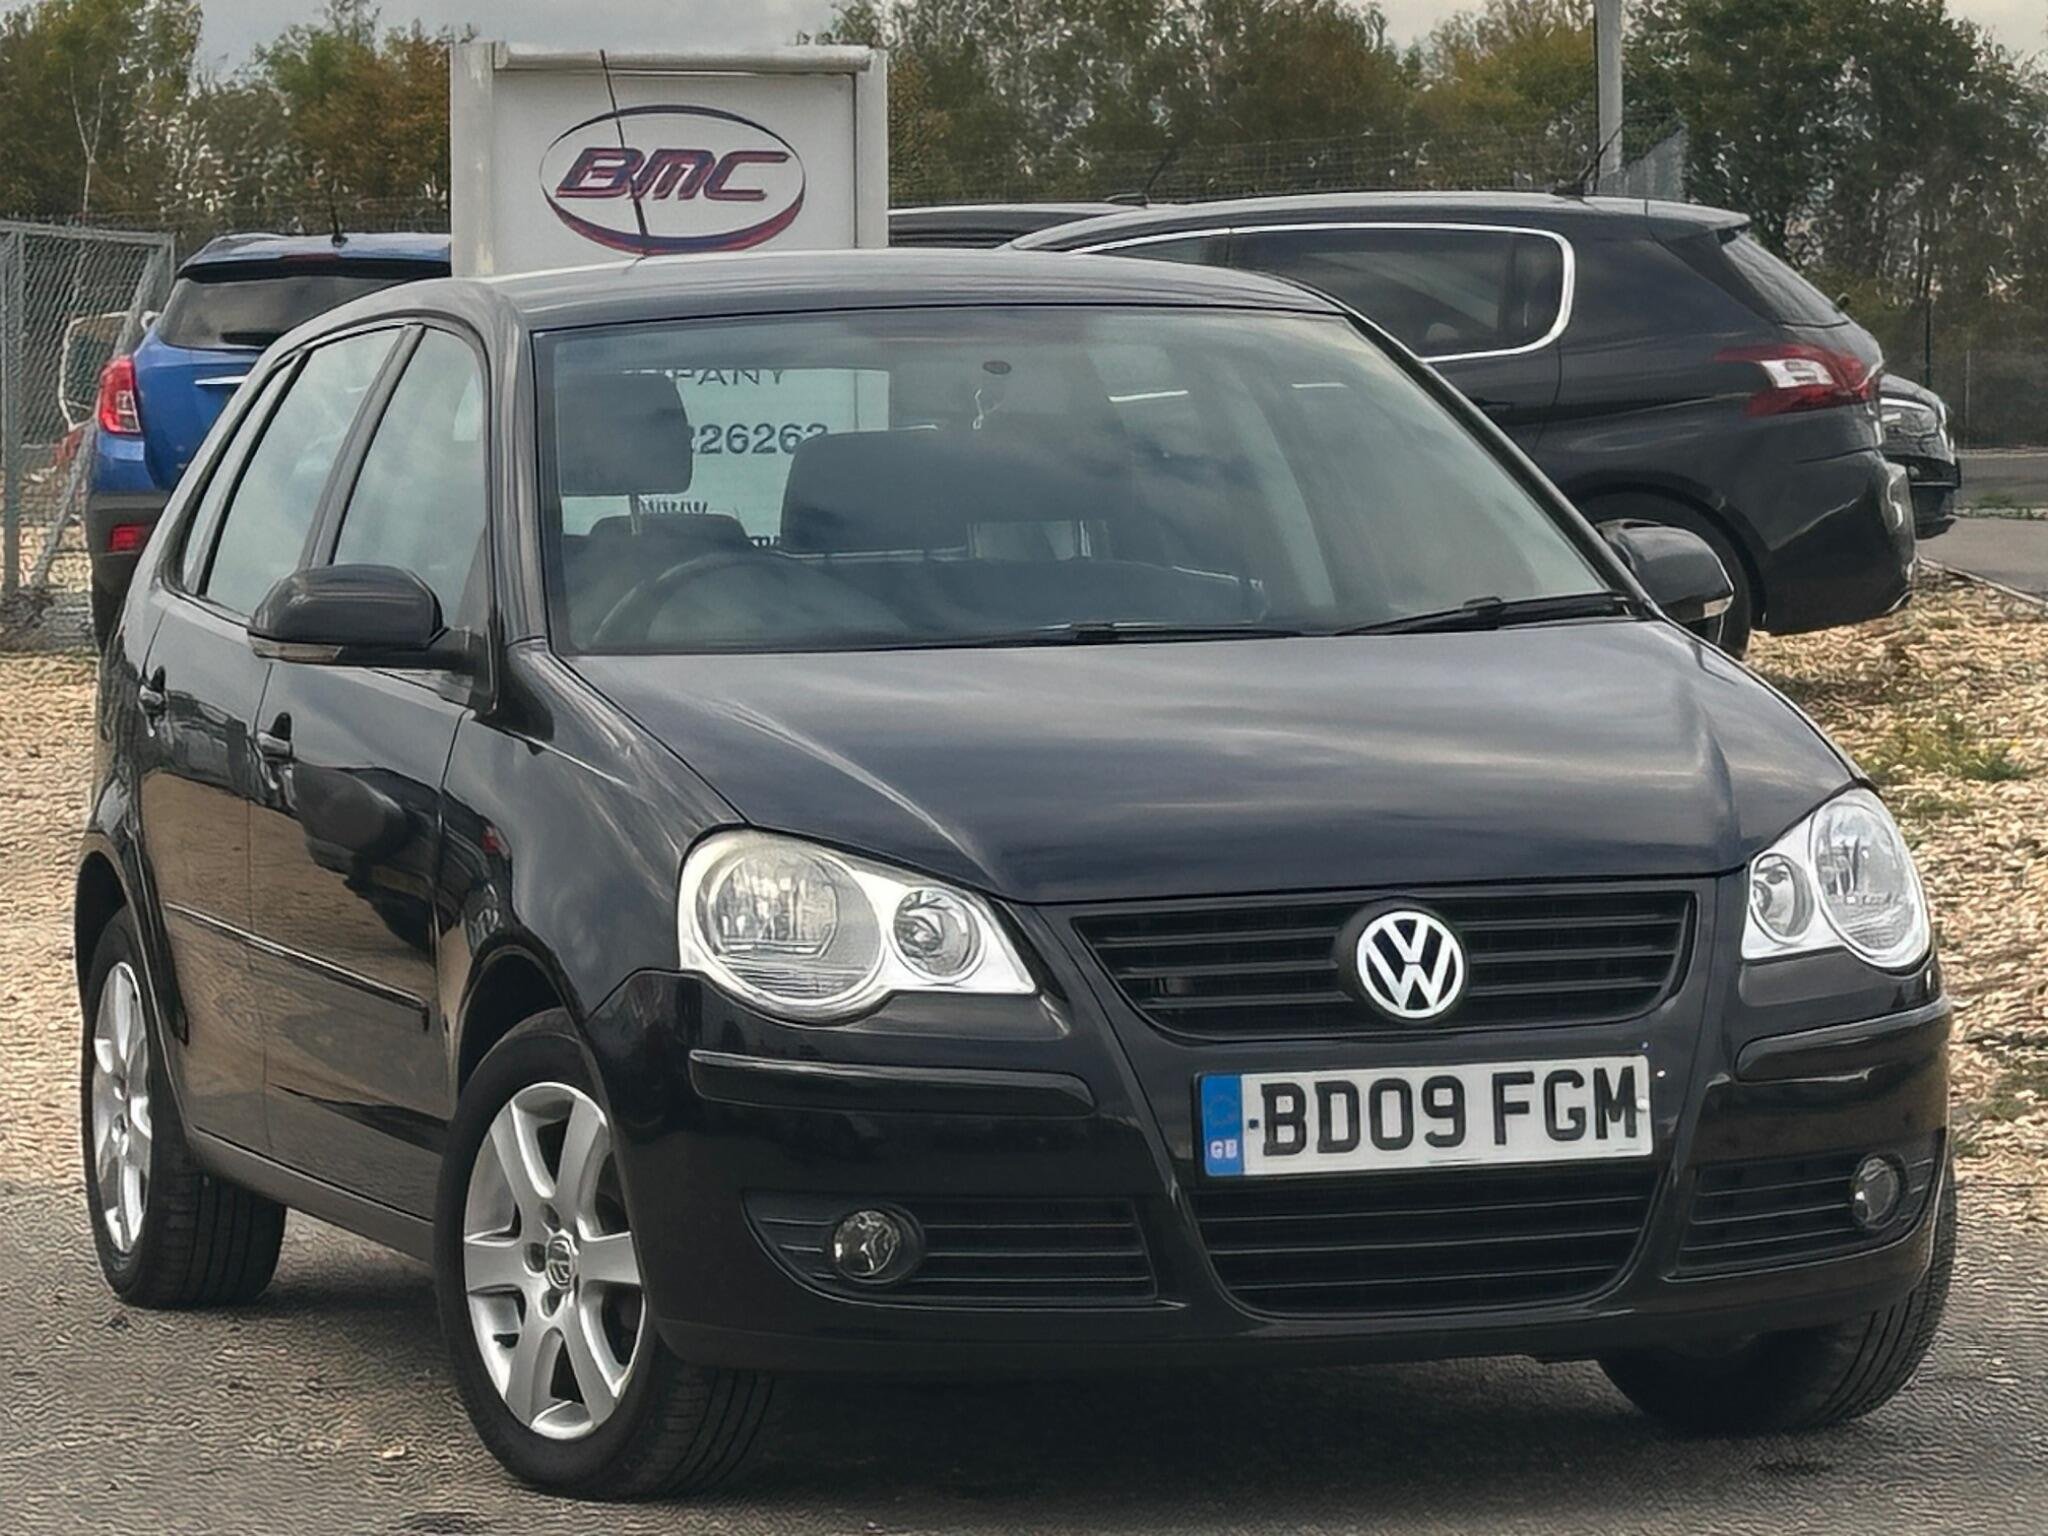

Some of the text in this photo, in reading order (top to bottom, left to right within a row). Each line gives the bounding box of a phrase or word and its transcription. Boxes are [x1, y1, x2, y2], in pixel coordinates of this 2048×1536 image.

[555, 147, 791, 201] BMC
[687, 422, 829, 455] 2626
[1357, 911, 1464, 1019] VW
[1261, 1065, 1638, 1157] BD09 FGM
[1210, 1140, 1238, 1159] GB
